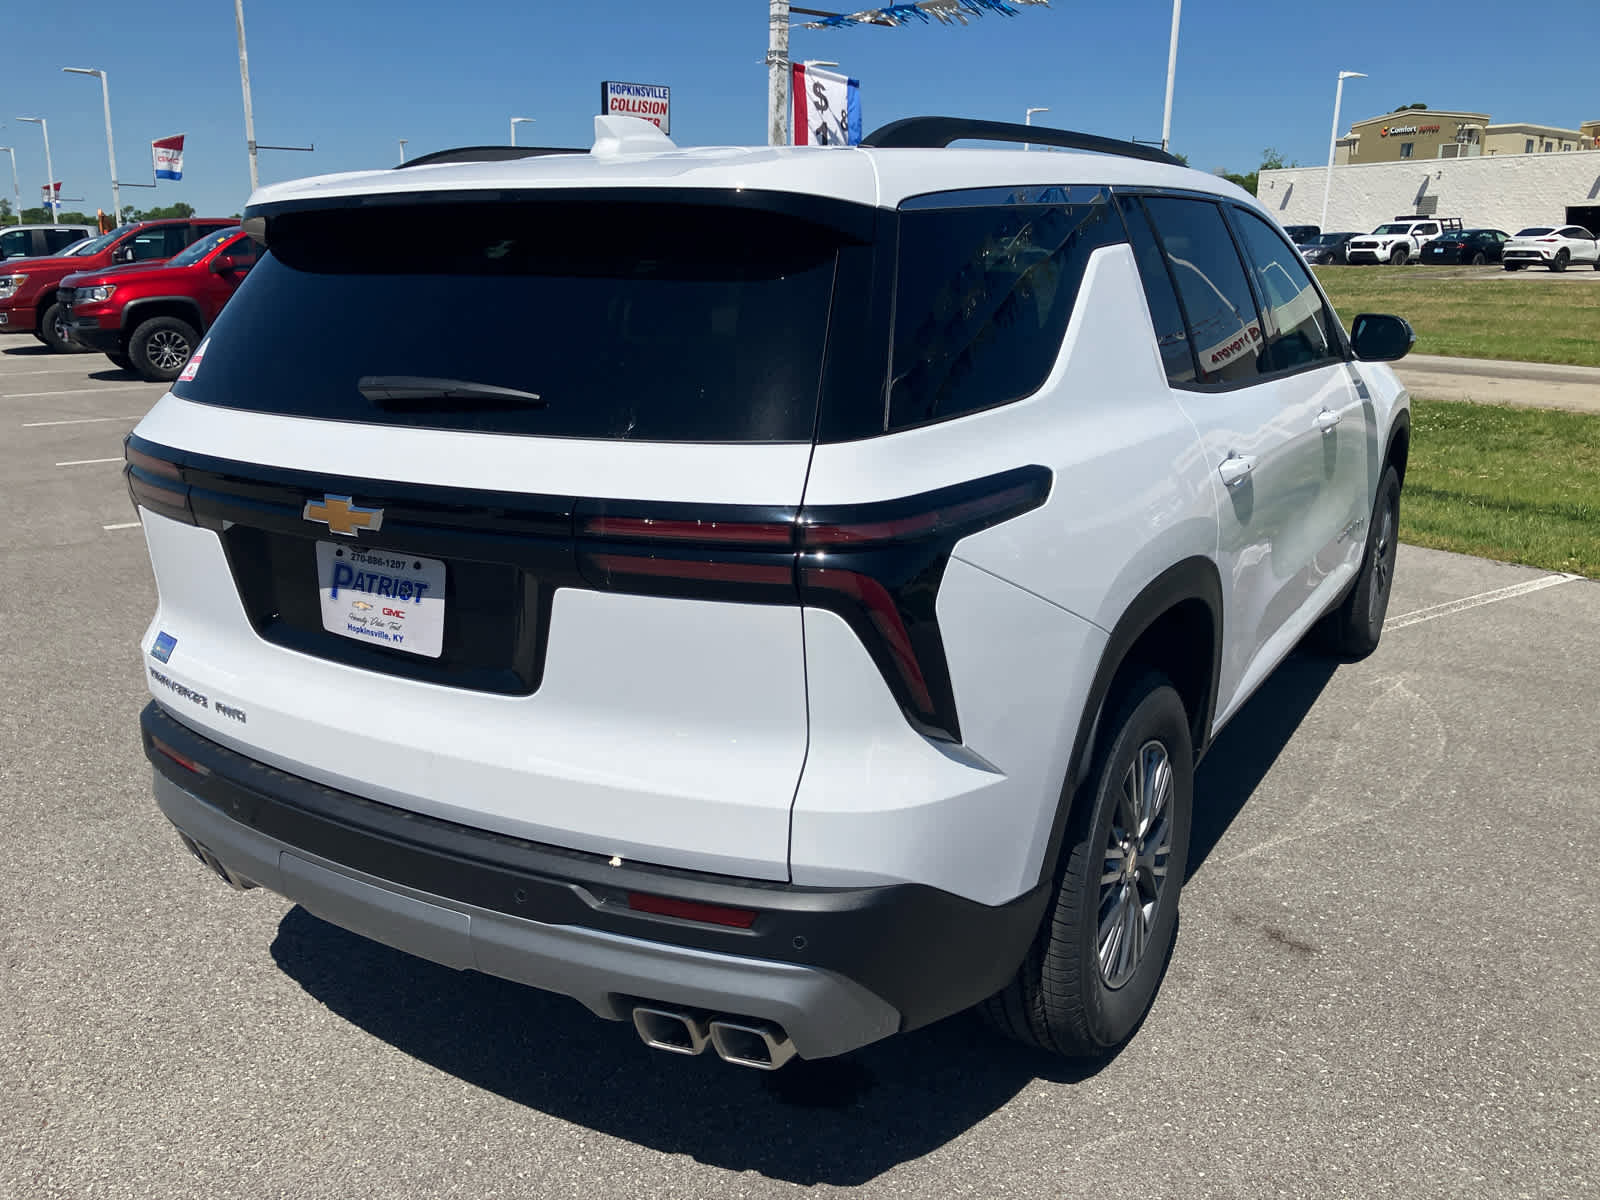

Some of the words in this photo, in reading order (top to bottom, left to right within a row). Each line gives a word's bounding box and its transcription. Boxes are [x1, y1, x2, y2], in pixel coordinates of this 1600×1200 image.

[609, 83, 667, 99] HOPKINSVILLE
[610, 97, 667, 115] COLLISION
[1390, 125, 1417, 135] Comfort
[331, 561, 429, 603] PATRIOT
[382, 607, 405, 619] GMC
[347, 623, 391, 640] Hopkinsville,
[392, 634, 405, 643] KY
